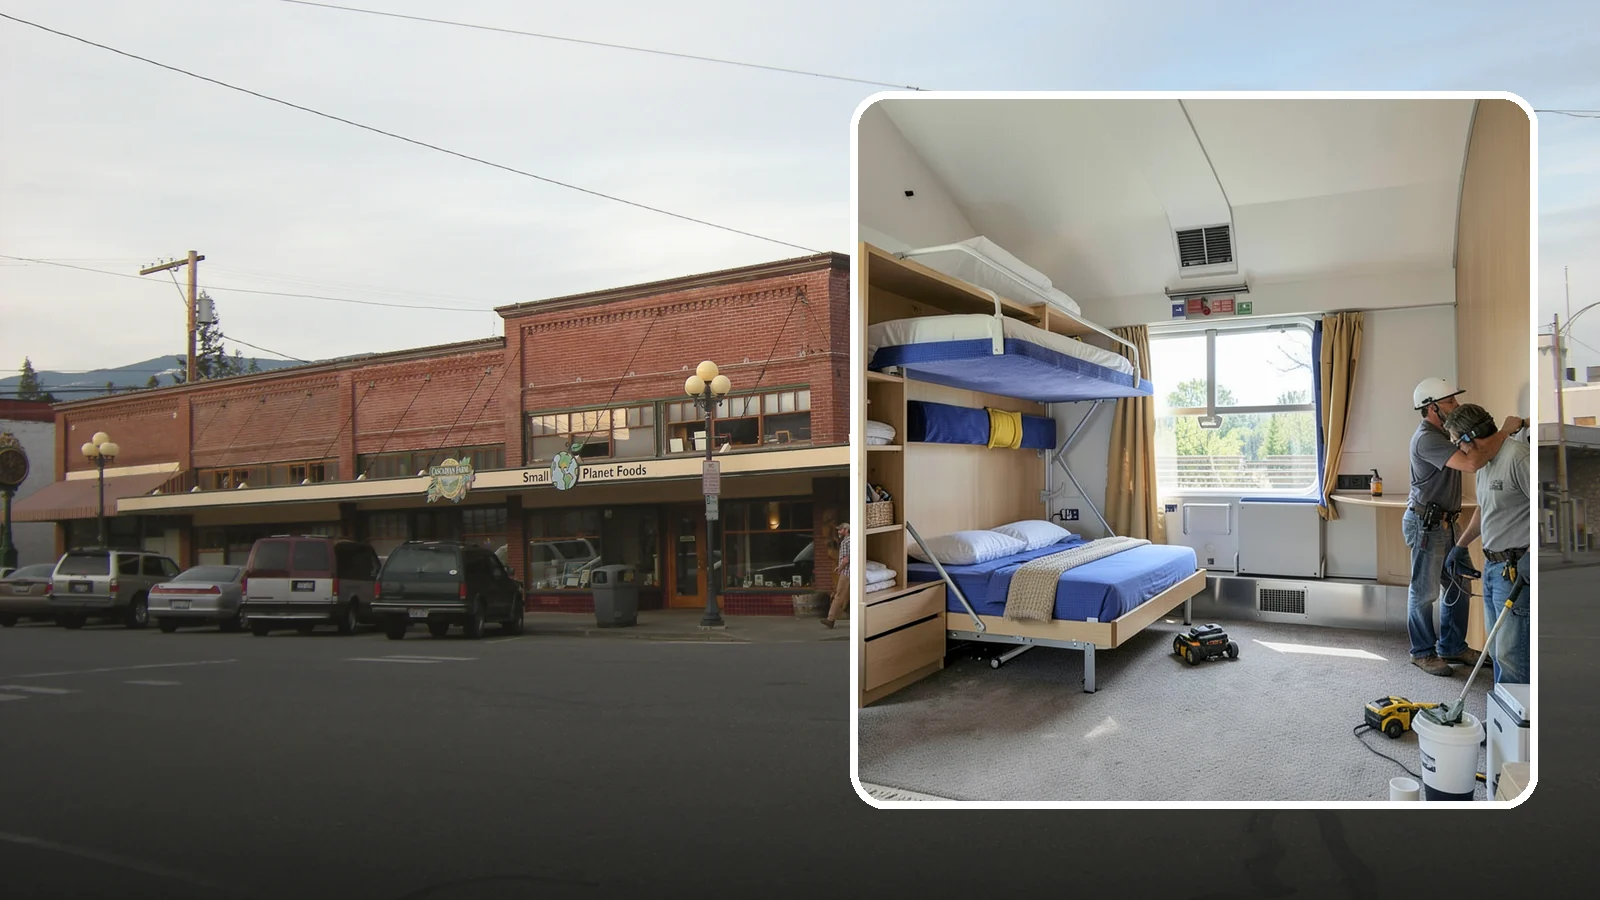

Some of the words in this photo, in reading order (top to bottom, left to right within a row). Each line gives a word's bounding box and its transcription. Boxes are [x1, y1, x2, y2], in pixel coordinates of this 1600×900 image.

[523, 472, 549, 482] Small
[583, 468, 614, 479] Planet
[617, 465, 647, 477] Foods
